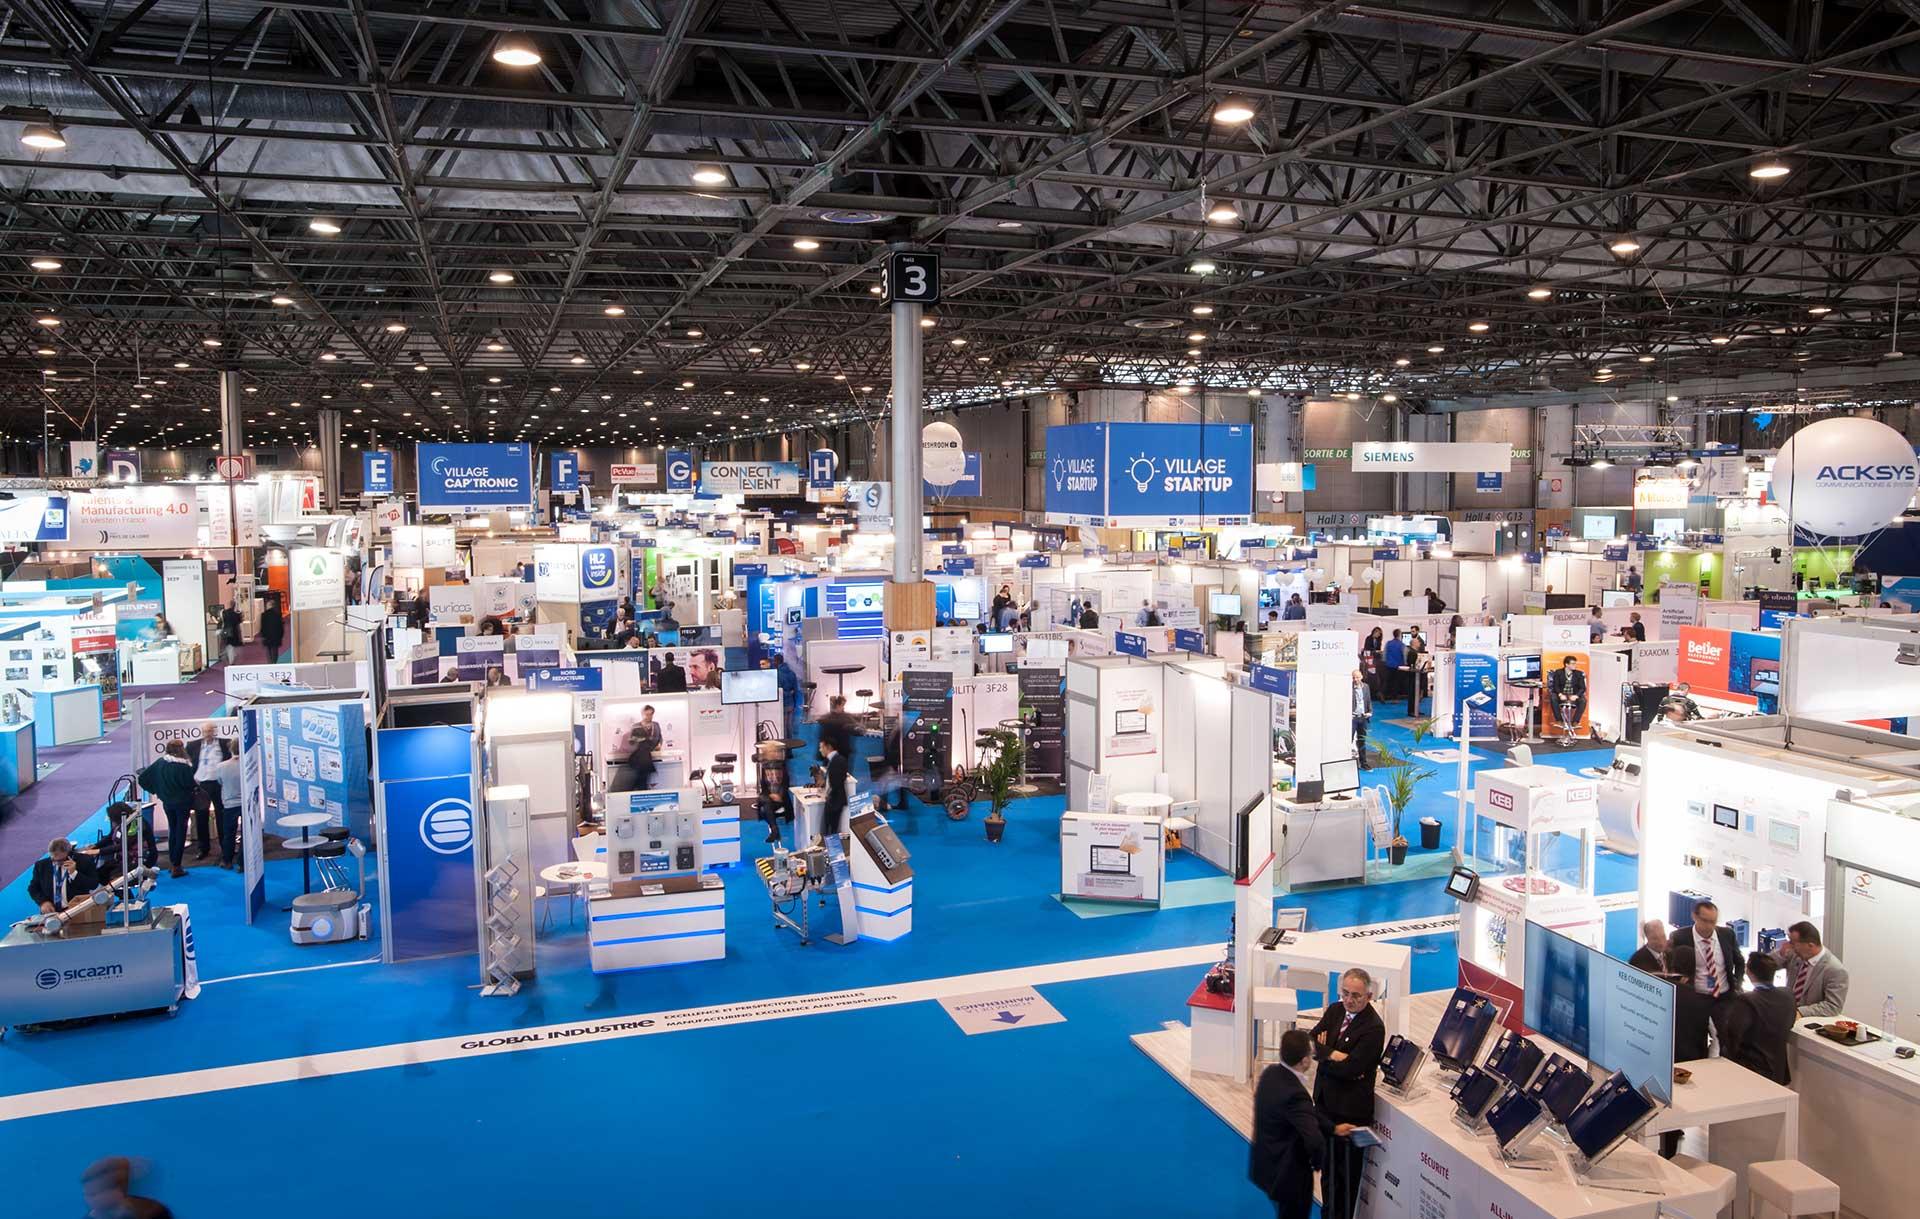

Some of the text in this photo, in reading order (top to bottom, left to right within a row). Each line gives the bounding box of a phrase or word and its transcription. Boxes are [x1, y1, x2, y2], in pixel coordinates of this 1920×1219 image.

[905, 266, 926, 296] 3
[1304, 449, 1348, 458] SORTIE DE
[1364, 452, 1414, 462] SIEMENS
[113, 460, 137, 482] D
[371, 460, 386, 482] E
[444, 467, 488, 476] VILLAGE
[559, 460, 572, 482] F
[670, 461, 690, 480] G
[710, 466, 772, 478] CONNECT
[814, 458, 830, 480] H
[1068, 458, 1094, 474] VILLAGE
[1164, 458, 1226, 474] VILLAGE
[1816, 466, 1914, 480] ACKSYS
[445, 478, 518, 488] CAP'TRONIC
[742, 478, 780, 490] EVENT
[1068, 476, 1098, 492] STARTUP
[1164, 477, 1232, 492] STARTUP
[81, 502, 188, 516] Manufacturing 4.0
[1318, 514, 1336, 524] Hall
[1339, 515, 1344, 524] 3
[1465, 512, 1522, 522] Hall 4 G13
[589, 553, 606, 564] HL2
[1639, 648, 1669, 657] EXAKOM
[986, 683, 1008, 693] 3F28
[1491, 790, 1512, 809] KEB
[1568, 789, 1591, 801] KEB
[1342, 928, 1400, 939] GLOBAL
[664, 1010, 719, 1019] EXCELLENCE
[735, 1000, 798, 1011] PERSPECTIVES
[800, 992, 865, 1003] INDUSTRIELLES
[667, 1013, 752, 1026] MANUFACTURING
[755, 1006, 812, 1016] EXCELLENCE
[836, 995, 897, 1006] PERSPECTIVES
[461, 1034, 544, 1050] GLOBAL
[1420, 1151, 1449, 1180] SÉCURITÉ
